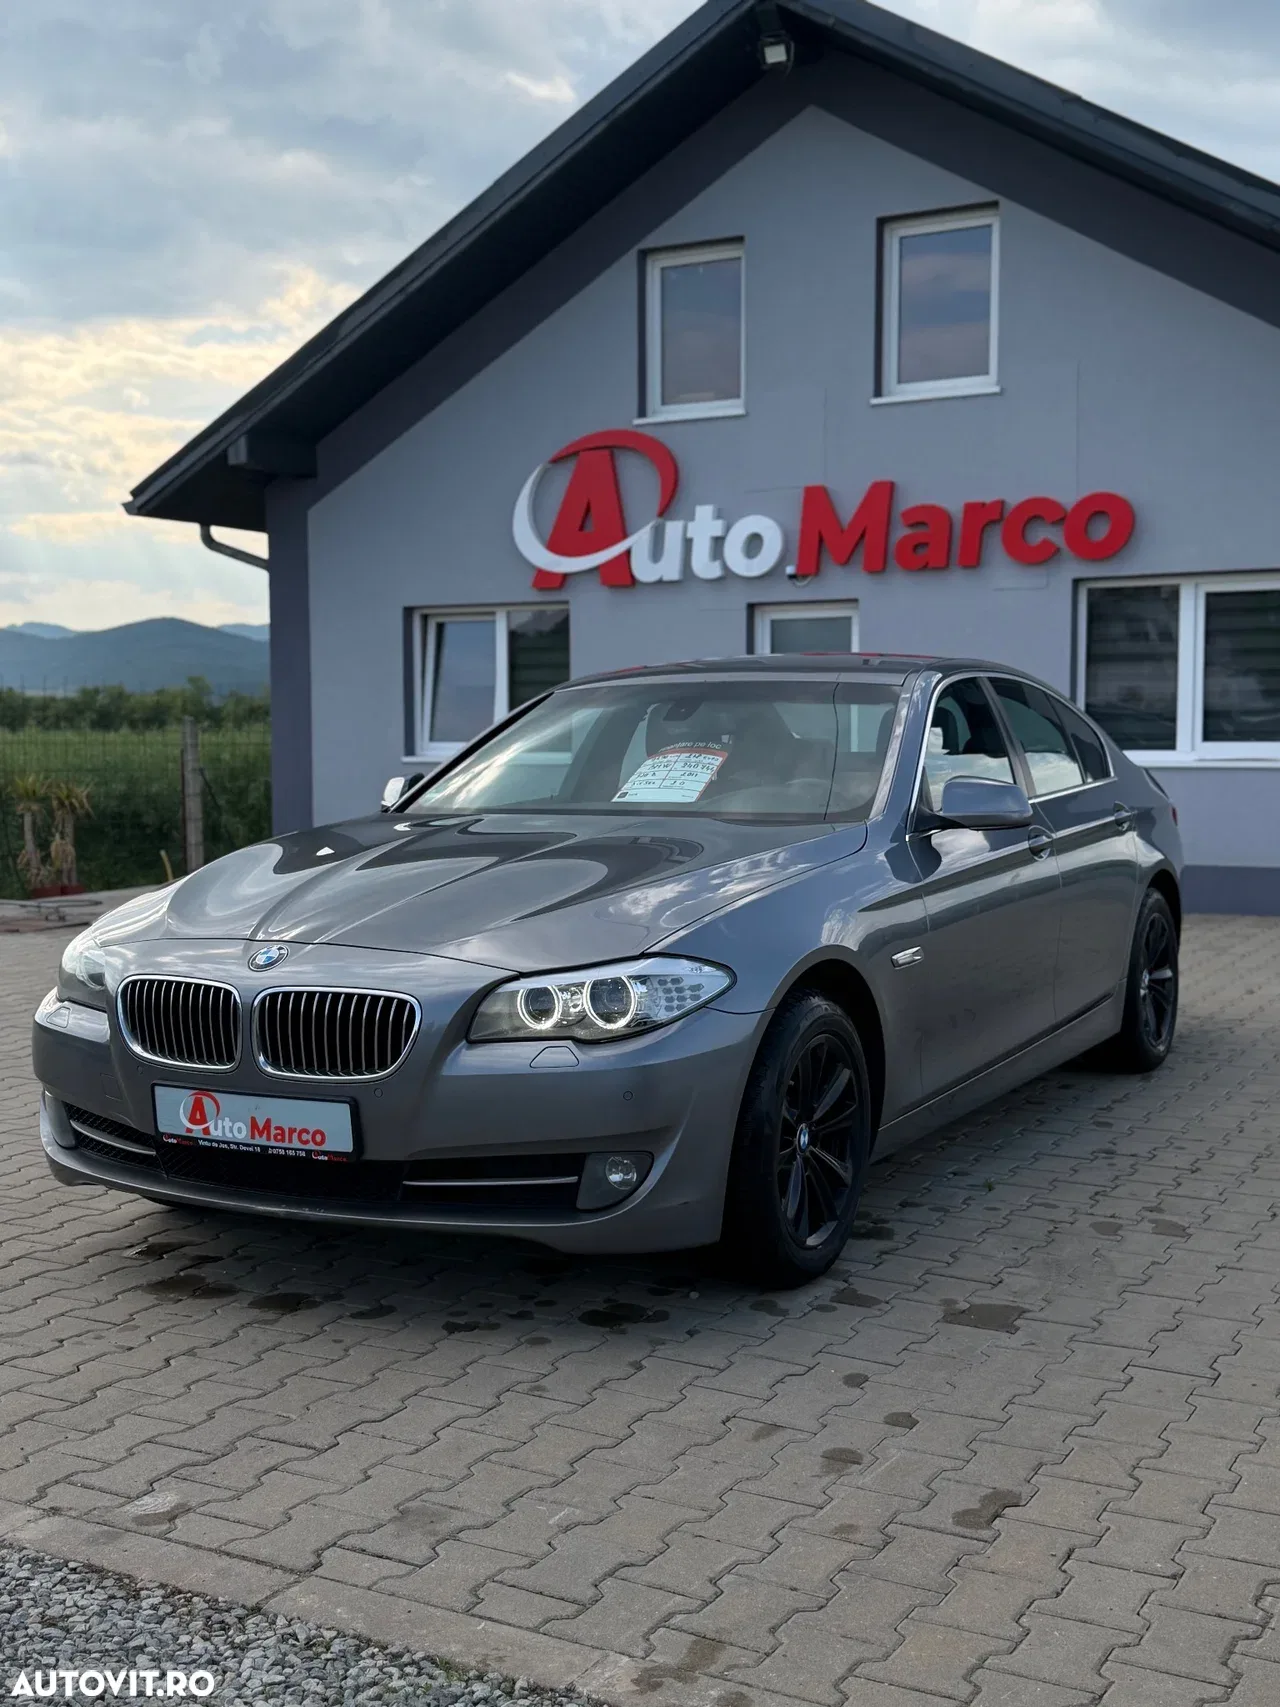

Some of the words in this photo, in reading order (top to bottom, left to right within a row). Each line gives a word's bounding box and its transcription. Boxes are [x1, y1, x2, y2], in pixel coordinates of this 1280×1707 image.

[512, 429, 784, 589] Auto
[796, 480, 1135, 577] Marco
[180, 1091, 247, 1139] Auto
[250, 1115, 326, 1147] Marco
